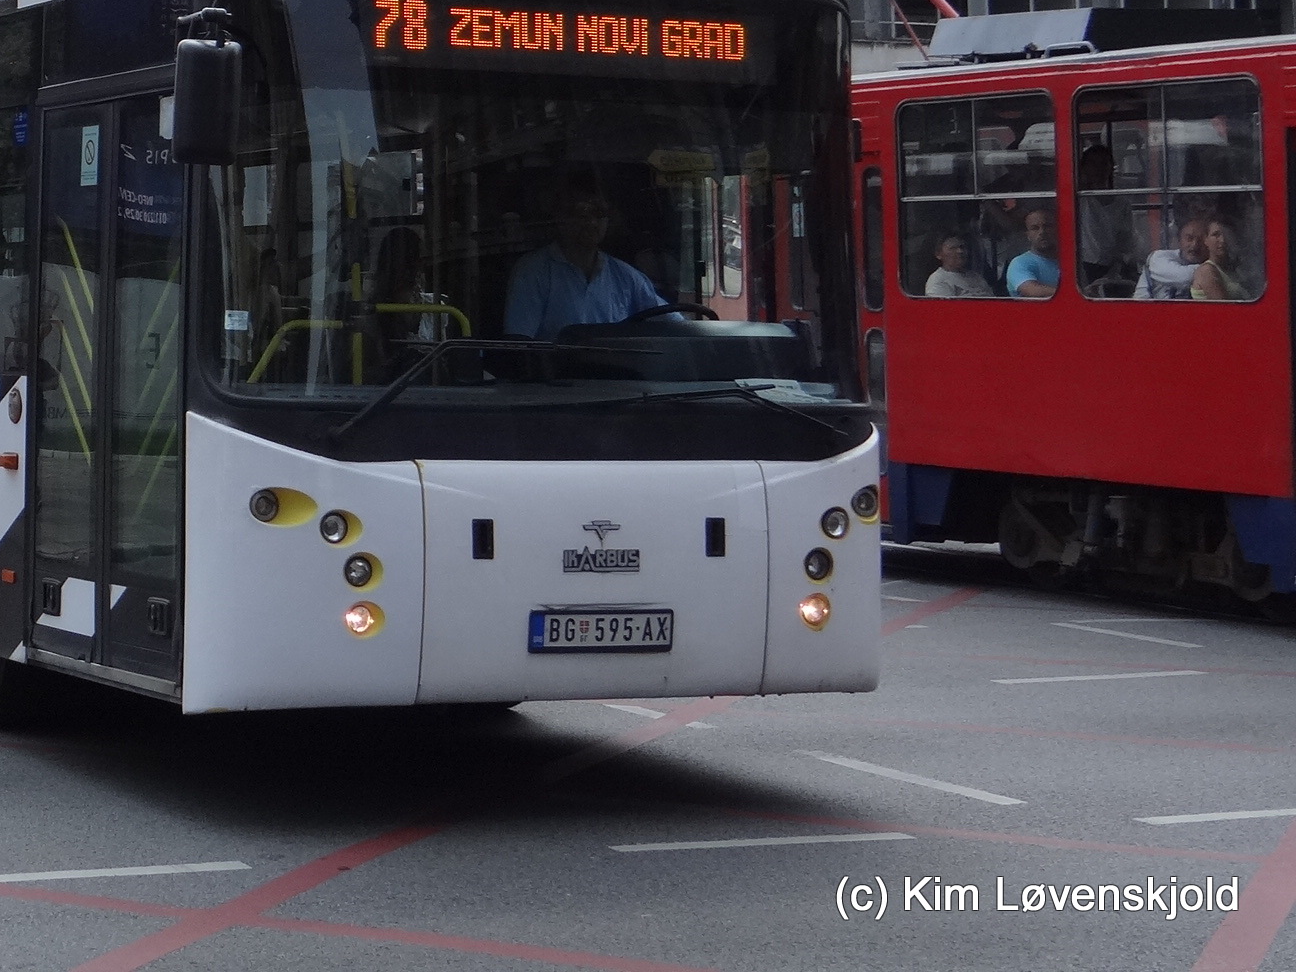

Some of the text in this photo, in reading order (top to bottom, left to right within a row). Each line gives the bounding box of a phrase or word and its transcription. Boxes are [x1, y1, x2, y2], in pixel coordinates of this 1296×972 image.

[450, 8, 563, 51] ZEMUN
[577, 14, 648, 55] NOVI
[661, 19, 745, 60] GRAD
[563, 545, 640, 572] IKARBUS
[549, 618, 576, 642] BG
